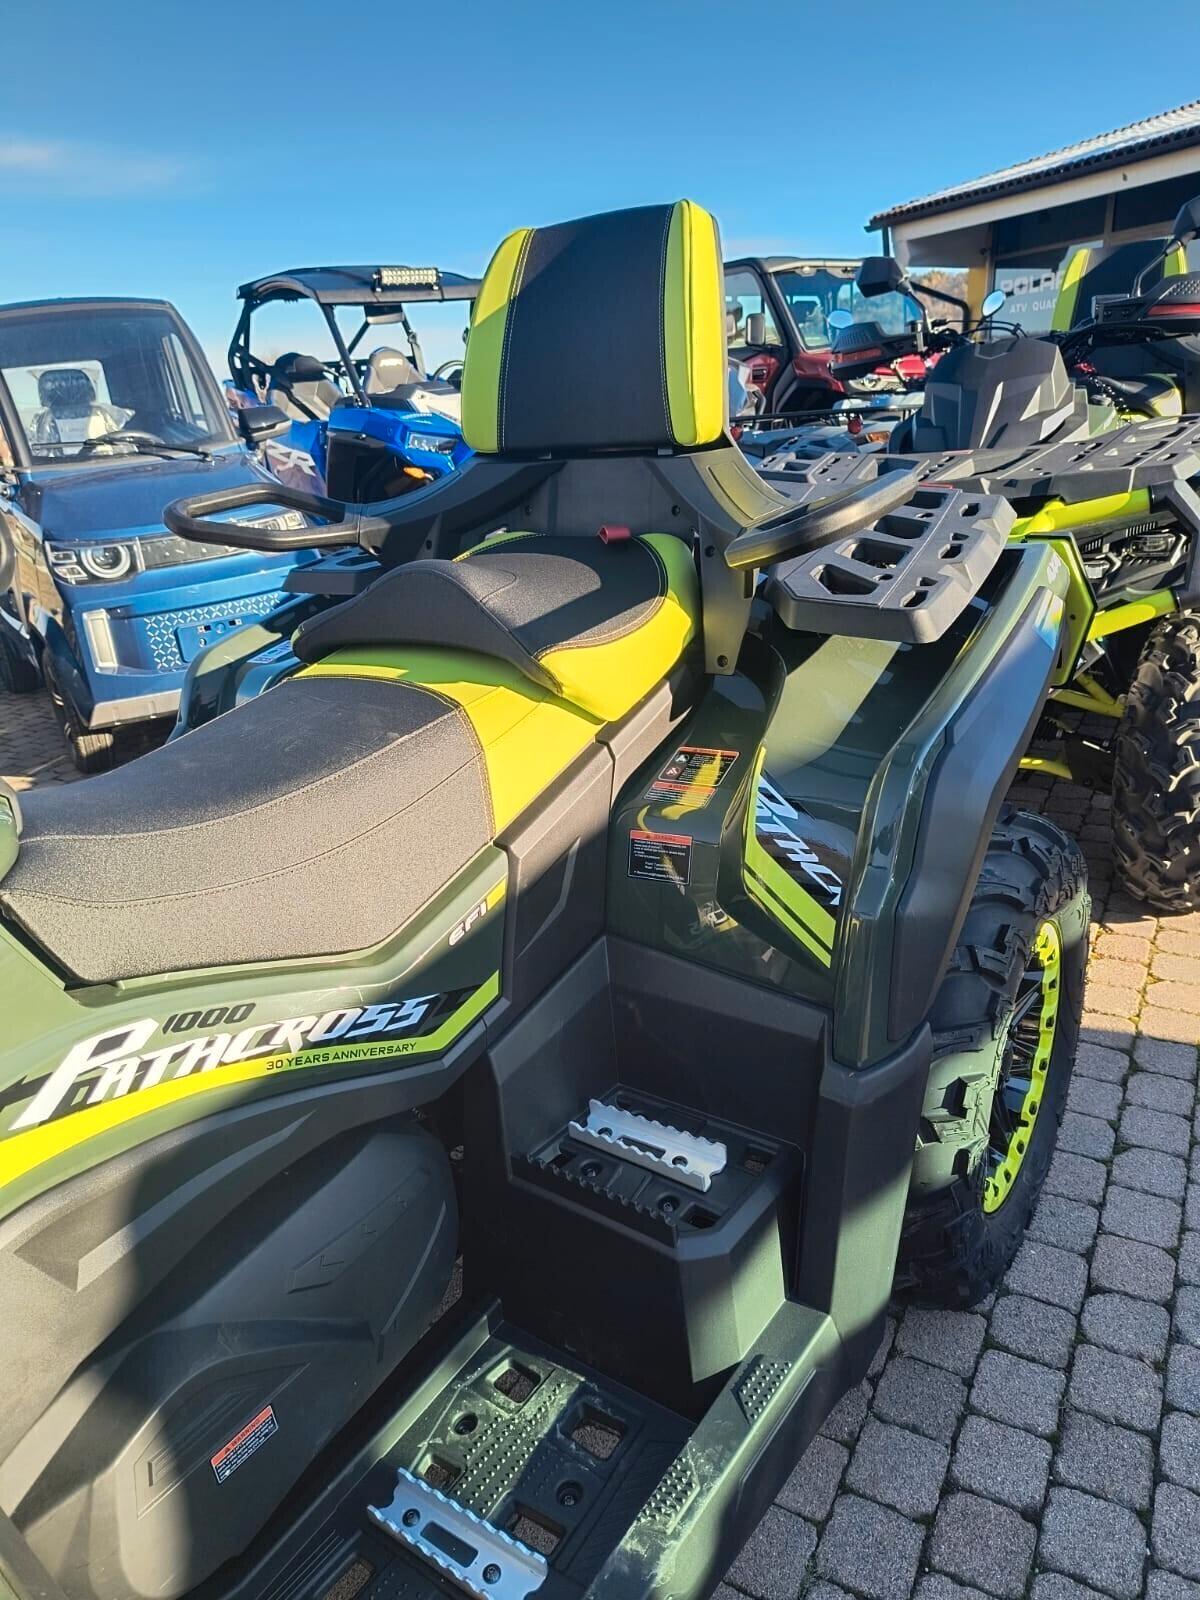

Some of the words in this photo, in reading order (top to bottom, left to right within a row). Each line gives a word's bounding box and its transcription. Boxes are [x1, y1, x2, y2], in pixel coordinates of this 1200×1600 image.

[1009, 303, 1028, 314] ATV
[448, 899, 488, 947] EFI
[162, 1003, 257, 1036] 1000
[8, 992, 440, 1132] PATHCROSS
[266, 1059, 284, 1072] 30
[286, 1053, 330, 1067] YEARS
[332, 1042, 417, 1061] ANNIVERSARY
